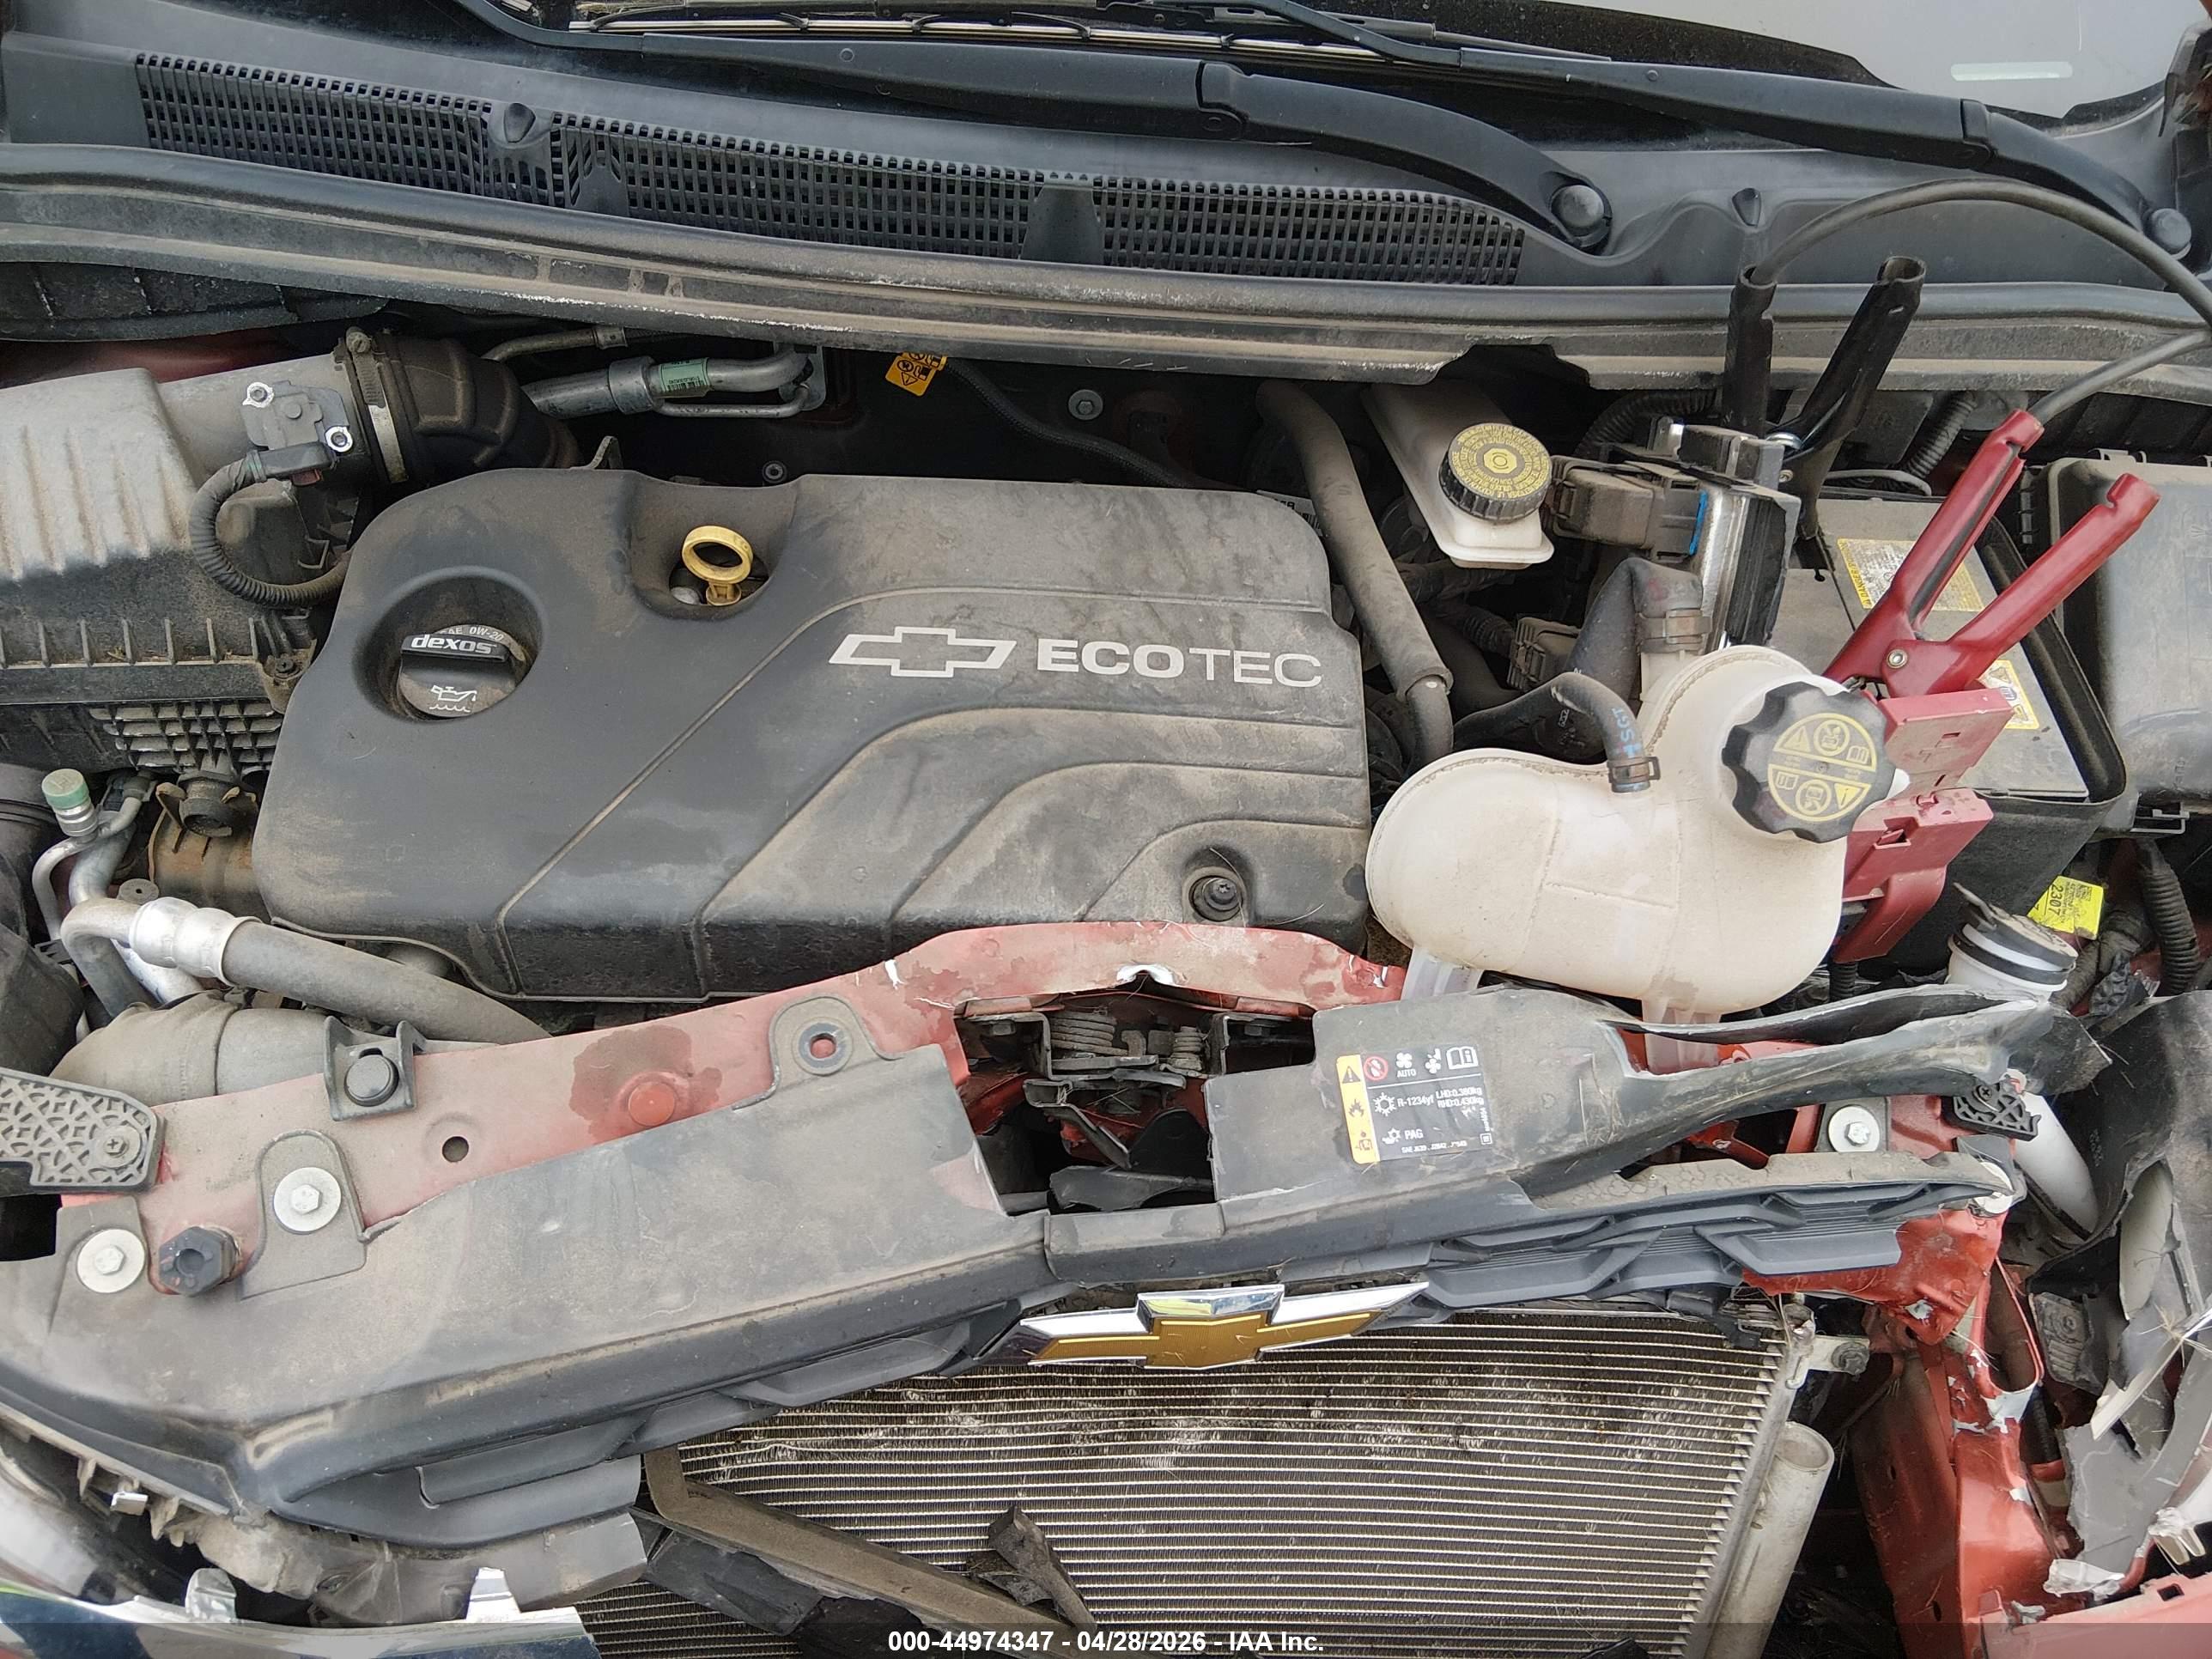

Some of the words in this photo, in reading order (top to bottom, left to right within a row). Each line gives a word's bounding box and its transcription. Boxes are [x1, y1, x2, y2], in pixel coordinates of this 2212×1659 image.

[439, 627, 463, 635] AE
[469, 626, 504, 641] 0W-20
[410, 634, 497, 654] dexos
[1037, 638, 1322, 688] ECOTEC
[2048, 884, 2064, 916] 2307
[1397, 1069, 1417, 1079] AUTO
[1397, 1094, 1434, 1108] R-1234yf
[1404, 1129, 1424, 1140] PAG
